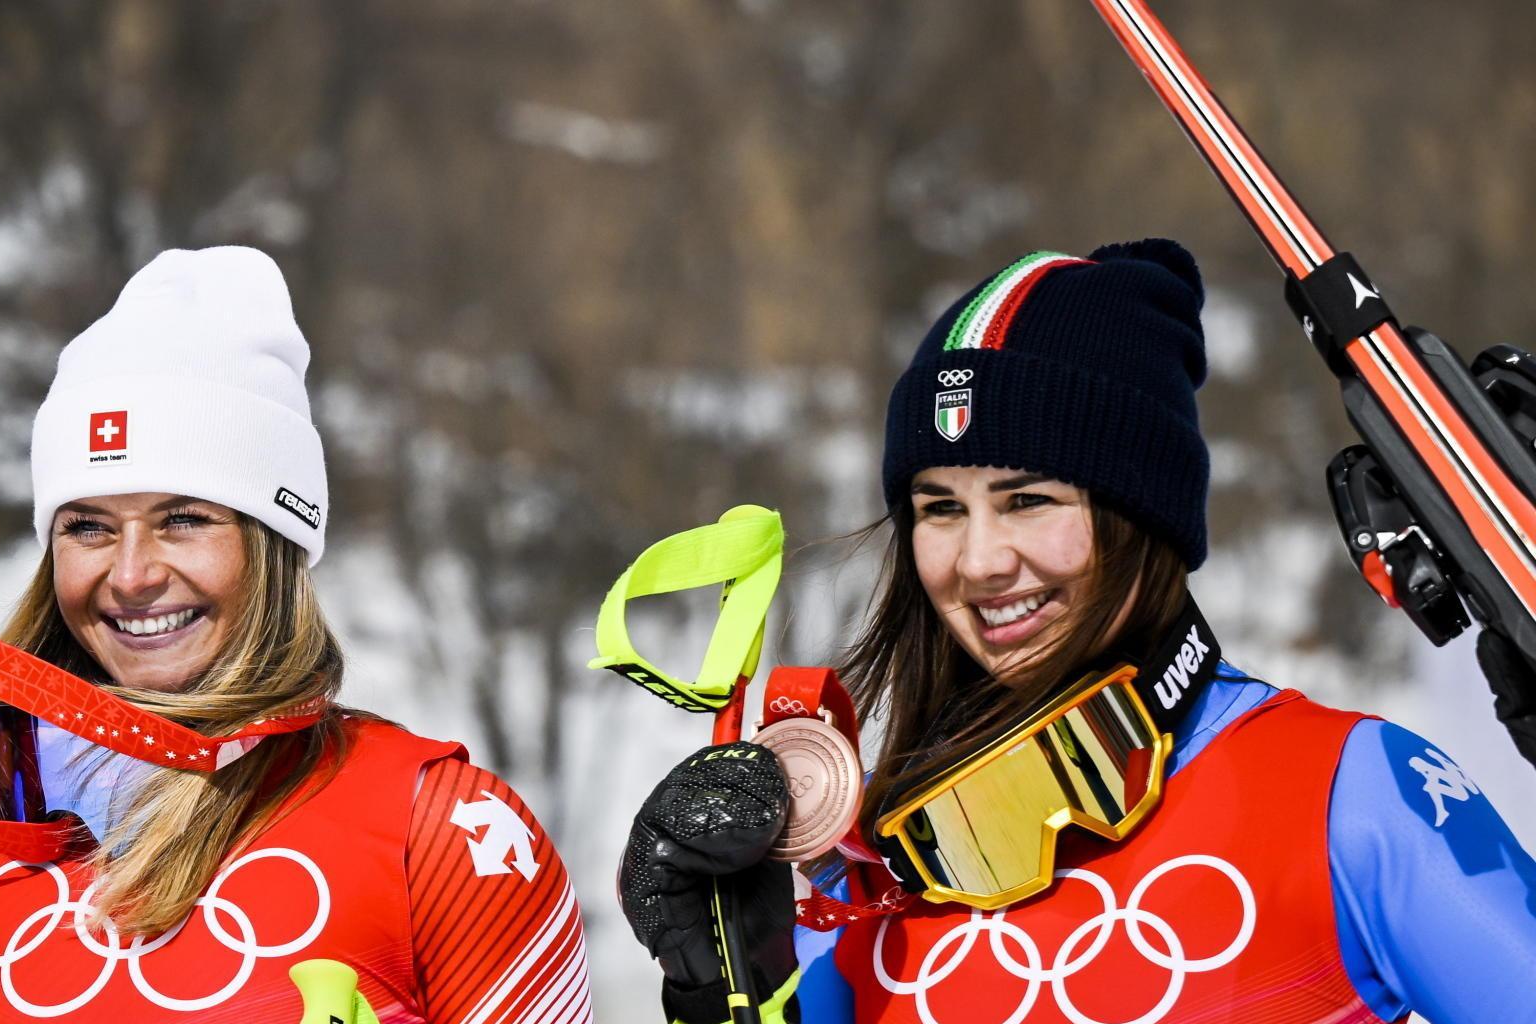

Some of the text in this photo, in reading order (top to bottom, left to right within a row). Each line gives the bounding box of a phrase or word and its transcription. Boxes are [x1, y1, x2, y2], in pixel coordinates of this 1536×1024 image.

[939, 393, 968, 403] ITALIA
[278, 490, 320, 526] reusch
[1153, 624, 1209, 710] uvex
